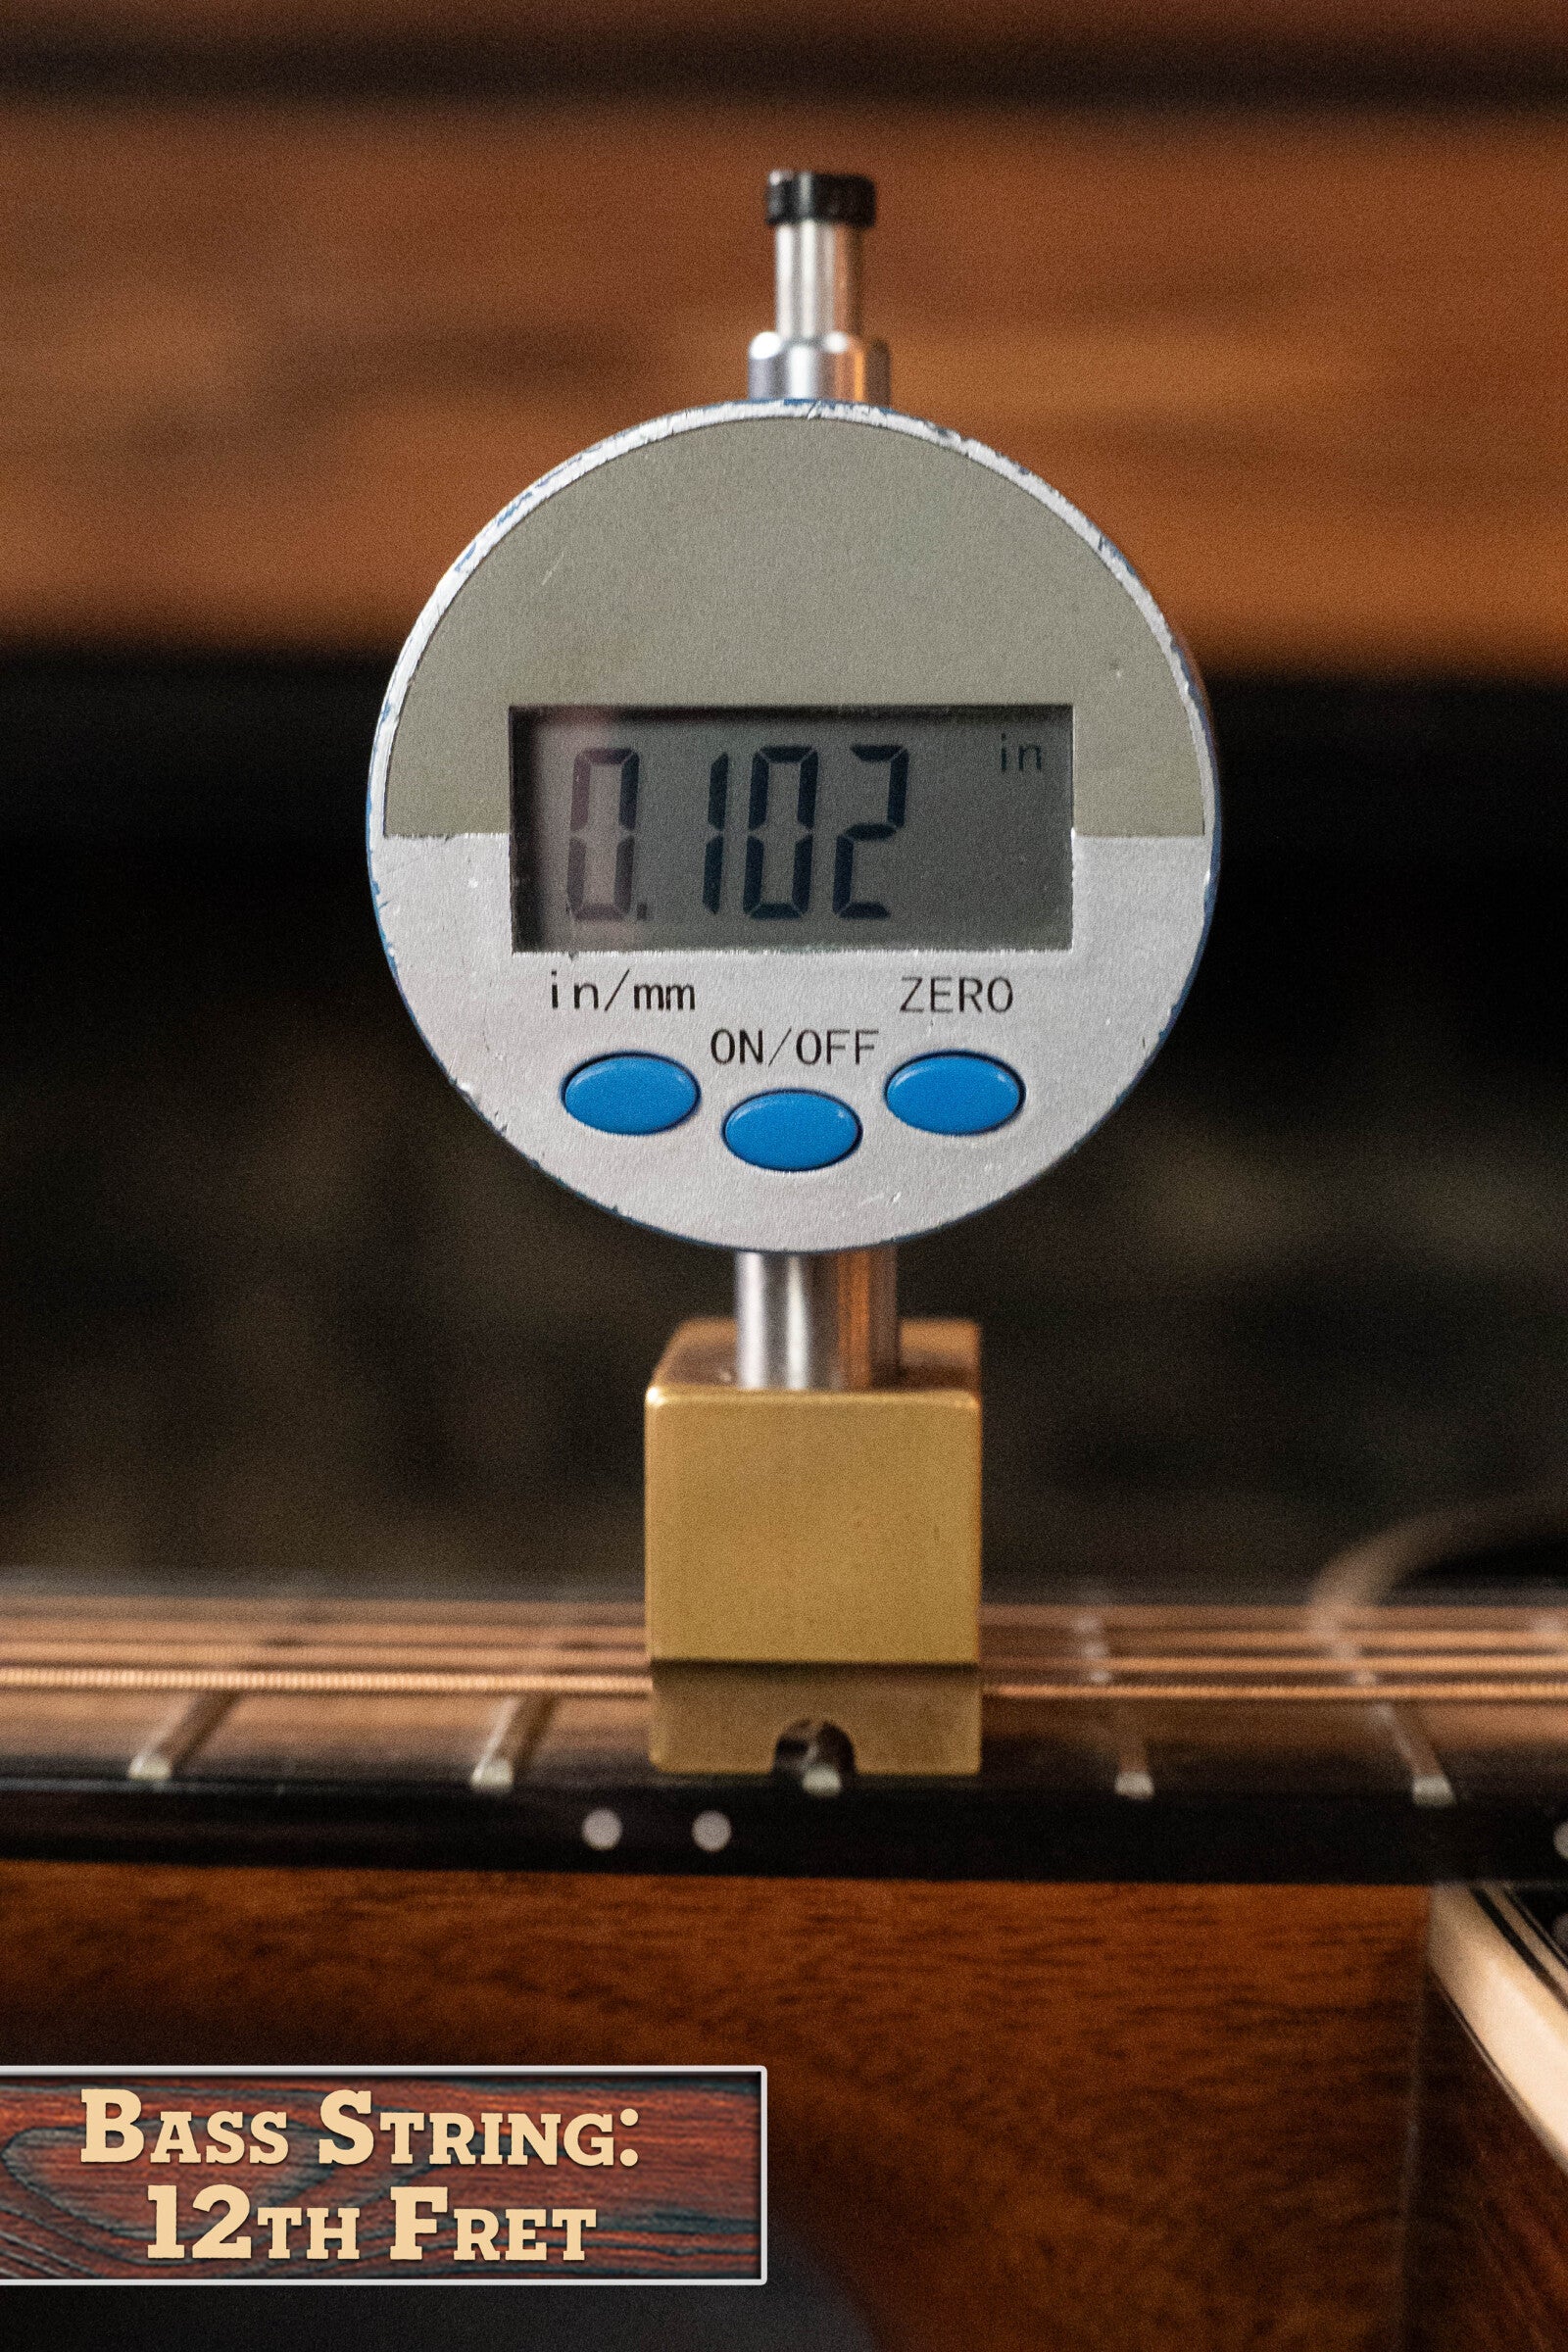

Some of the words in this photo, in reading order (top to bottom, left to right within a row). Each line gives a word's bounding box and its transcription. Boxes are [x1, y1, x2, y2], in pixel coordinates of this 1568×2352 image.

[566, 744, 909, 921] 0.102
[999, 732, 1044, 773] in
[550, 968, 697, 1012] in/mm
[899, 975, 1014, 1014] ZERO
[710, 1026, 880, 1067] ON/OFF
